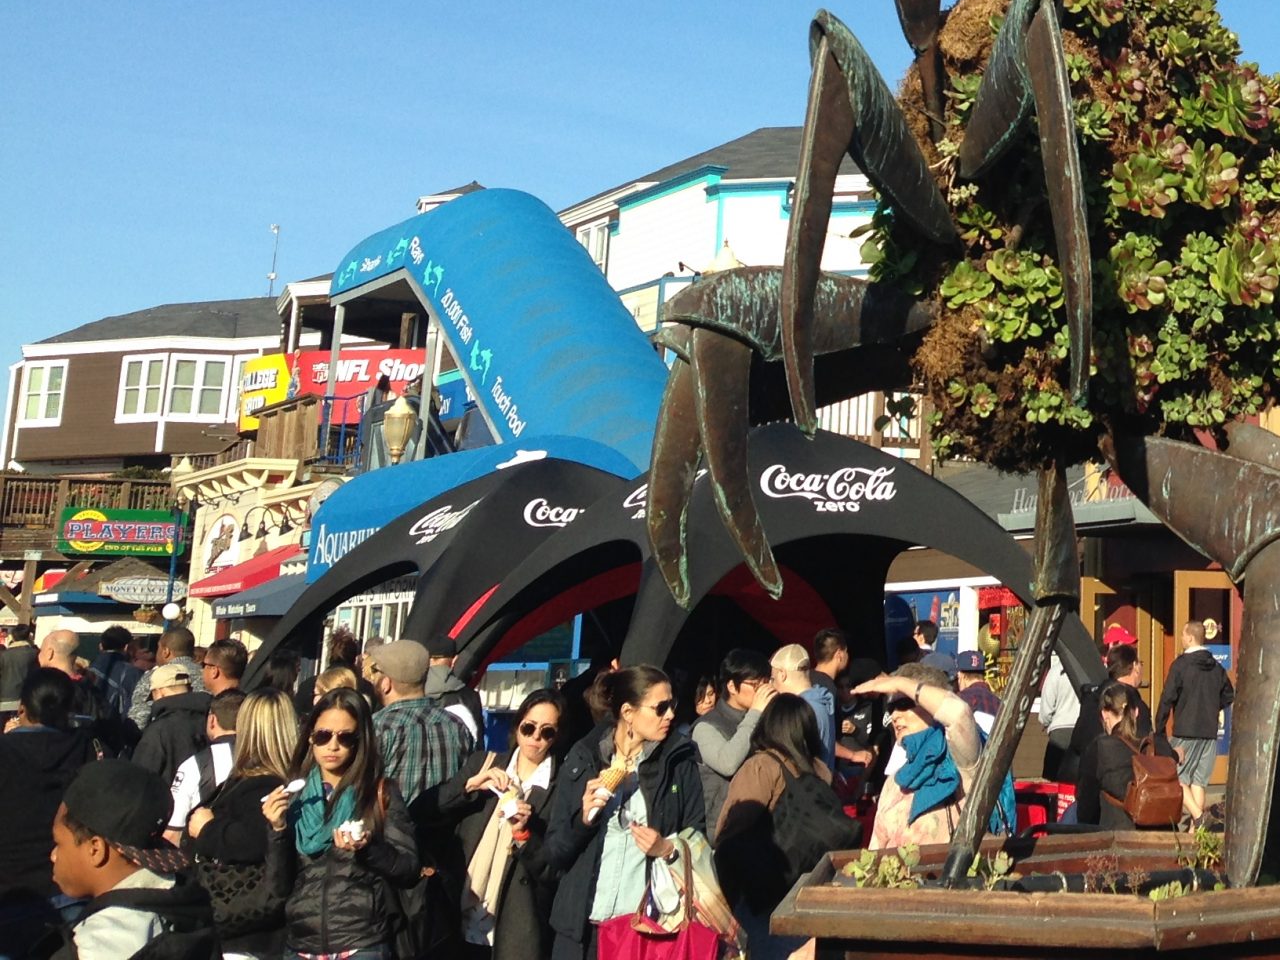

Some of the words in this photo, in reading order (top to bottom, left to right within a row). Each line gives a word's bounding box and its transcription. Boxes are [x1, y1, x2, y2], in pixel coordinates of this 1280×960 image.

[455, 314, 473, 345] Fish
[335, 359, 370, 382] NFL
[491, 376, 512, 416] Touch
[507, 406, 527, 438] Pool
[760, 464, 897, 500] Coca-Cola
[814, 501, 860, 512] zero
[106, 585, 137, 593] MONEY
[141, 585, 188, 593] EXCHNGE
